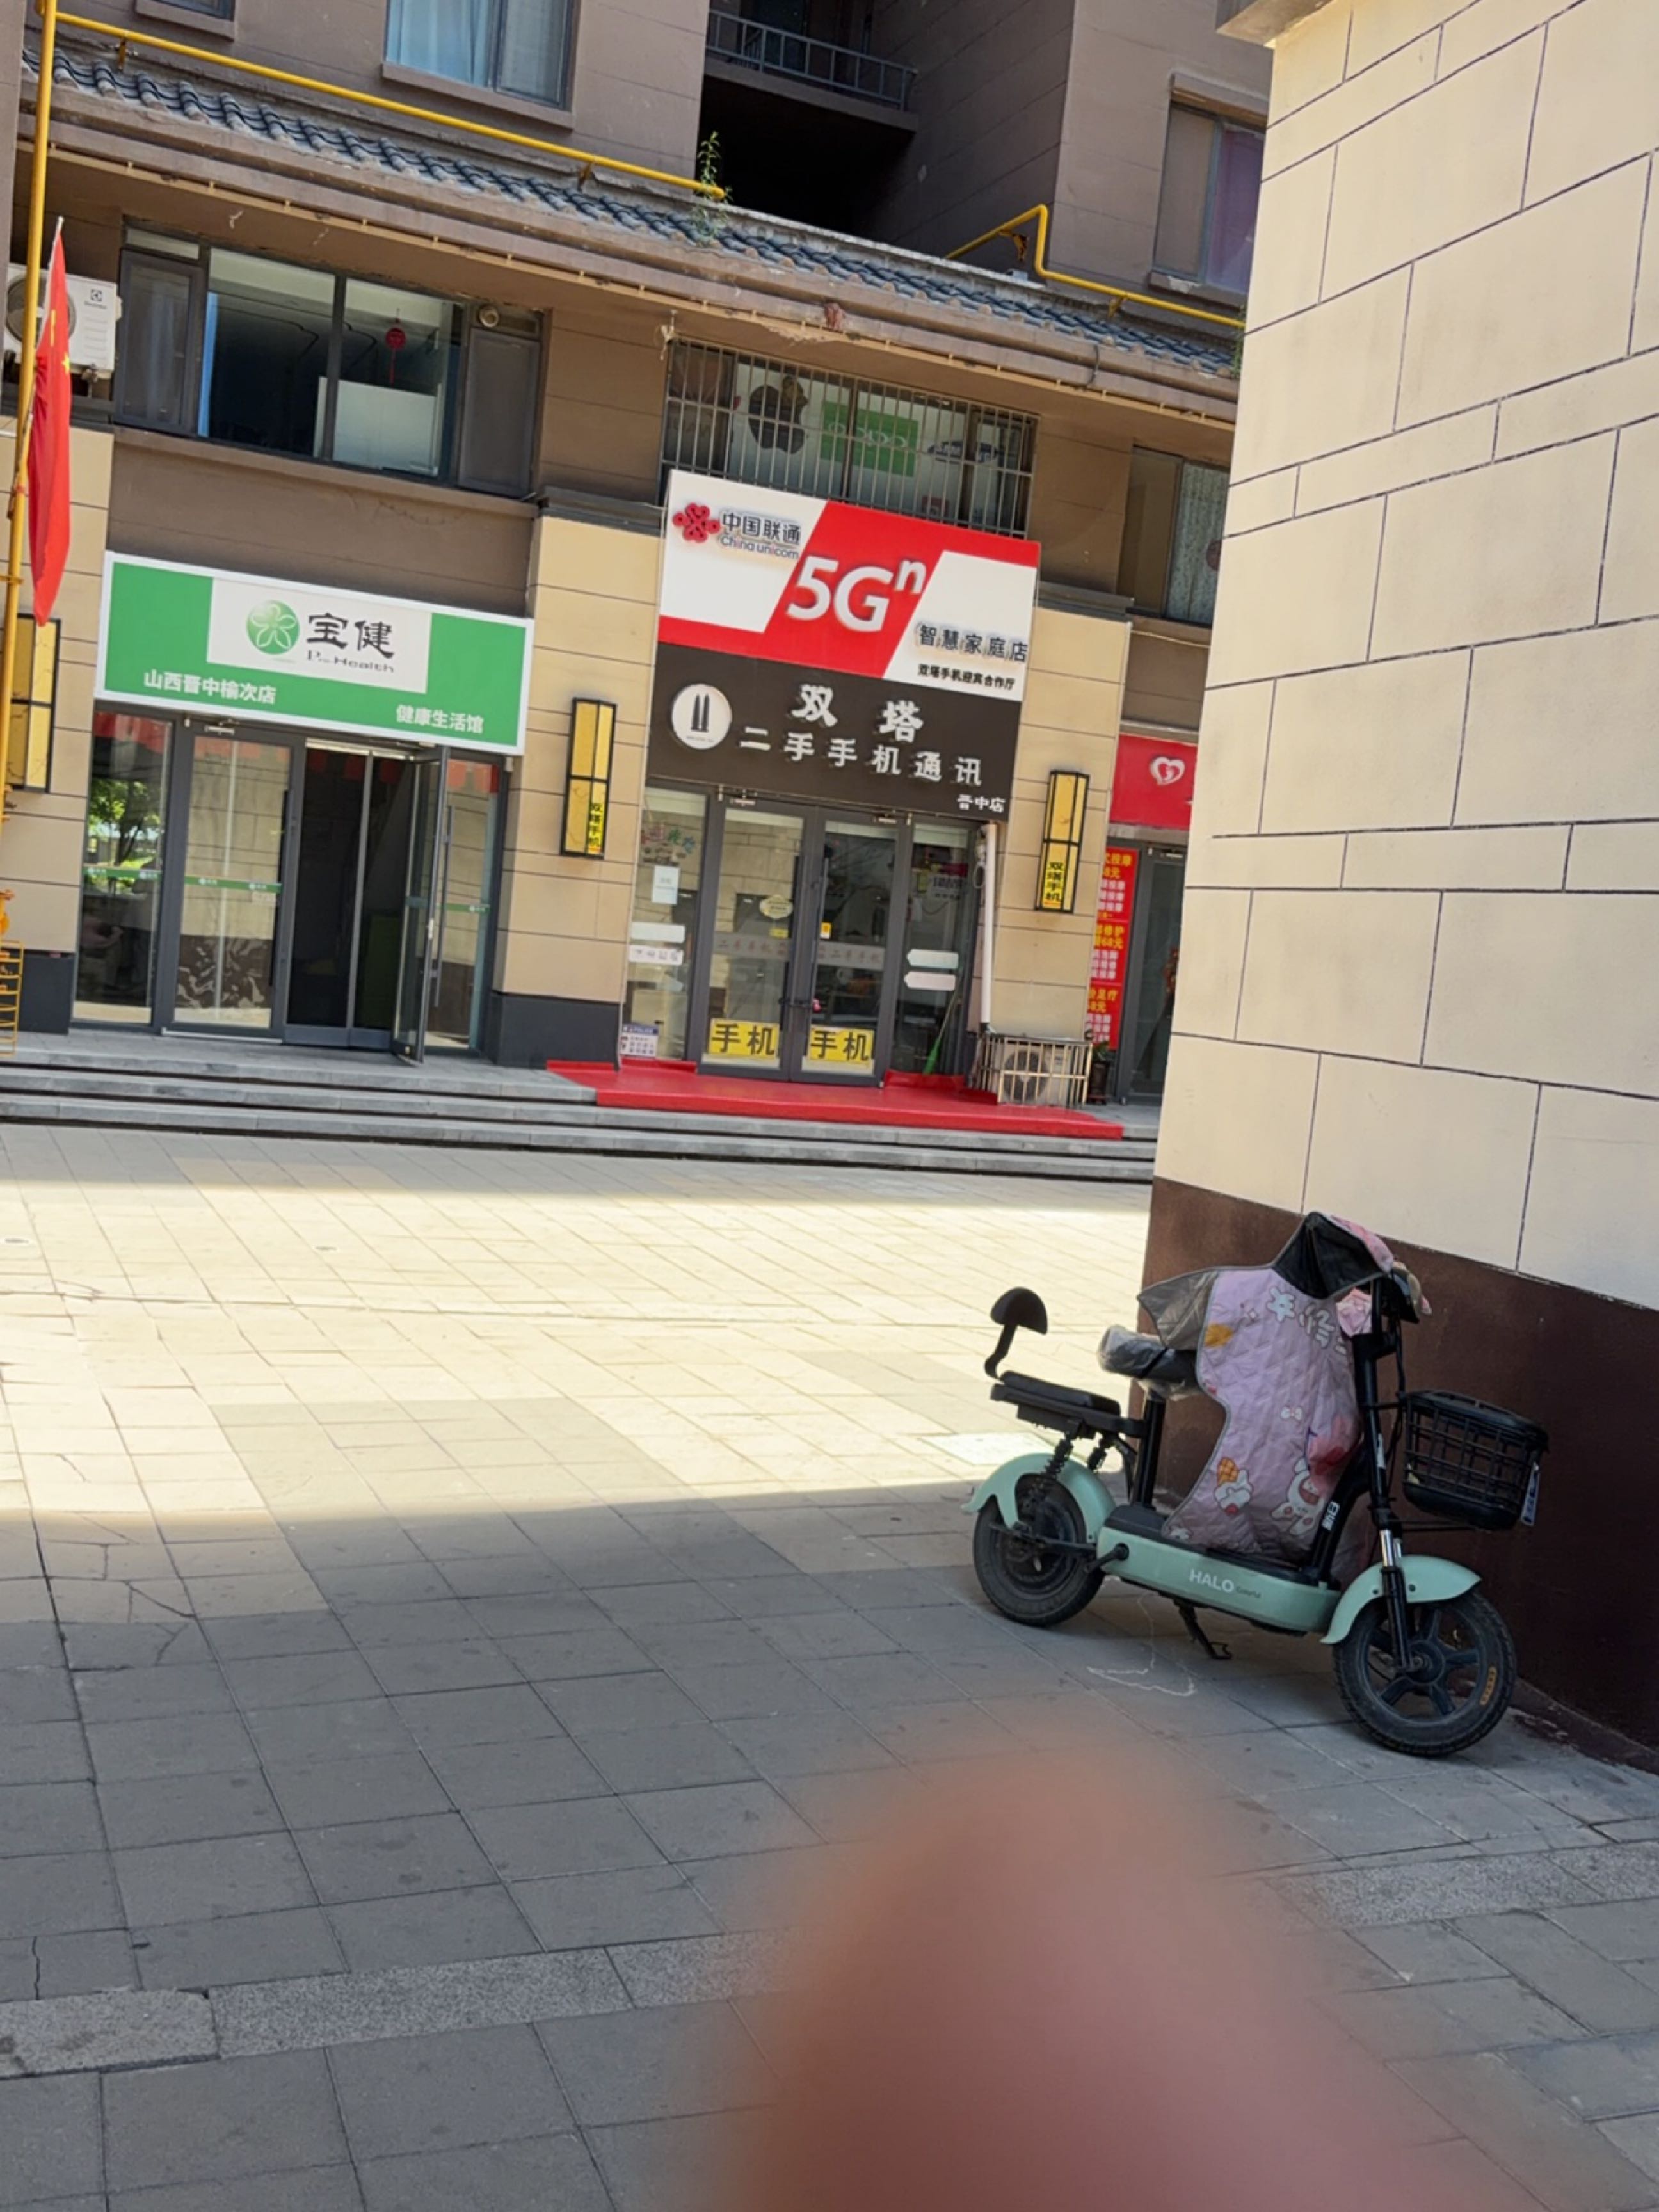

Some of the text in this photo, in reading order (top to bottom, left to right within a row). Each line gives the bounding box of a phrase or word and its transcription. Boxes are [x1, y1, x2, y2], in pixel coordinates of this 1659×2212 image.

[723, 512, 800, 546] 中国联通
[721, 534, 799, 559] China unicom
[307, 612, 394, 659] 宝健
[920, 625, 1028, 662] 智慧家庭店
[144, 669, 277, 705] 山西晋中榆次店
[397, 704, 484, 734] 健康生活馆
[792, 684, 924, 743] 双塔
[739, 726, 982, 786] 二手手机通讯
[957, 794, 1006, 813] 晋中店
[712, 1023, 775, 1056] 手机
[810, 1030, 869, 1061] 手机
[1189, 1569, 1235, 1593] HALO
